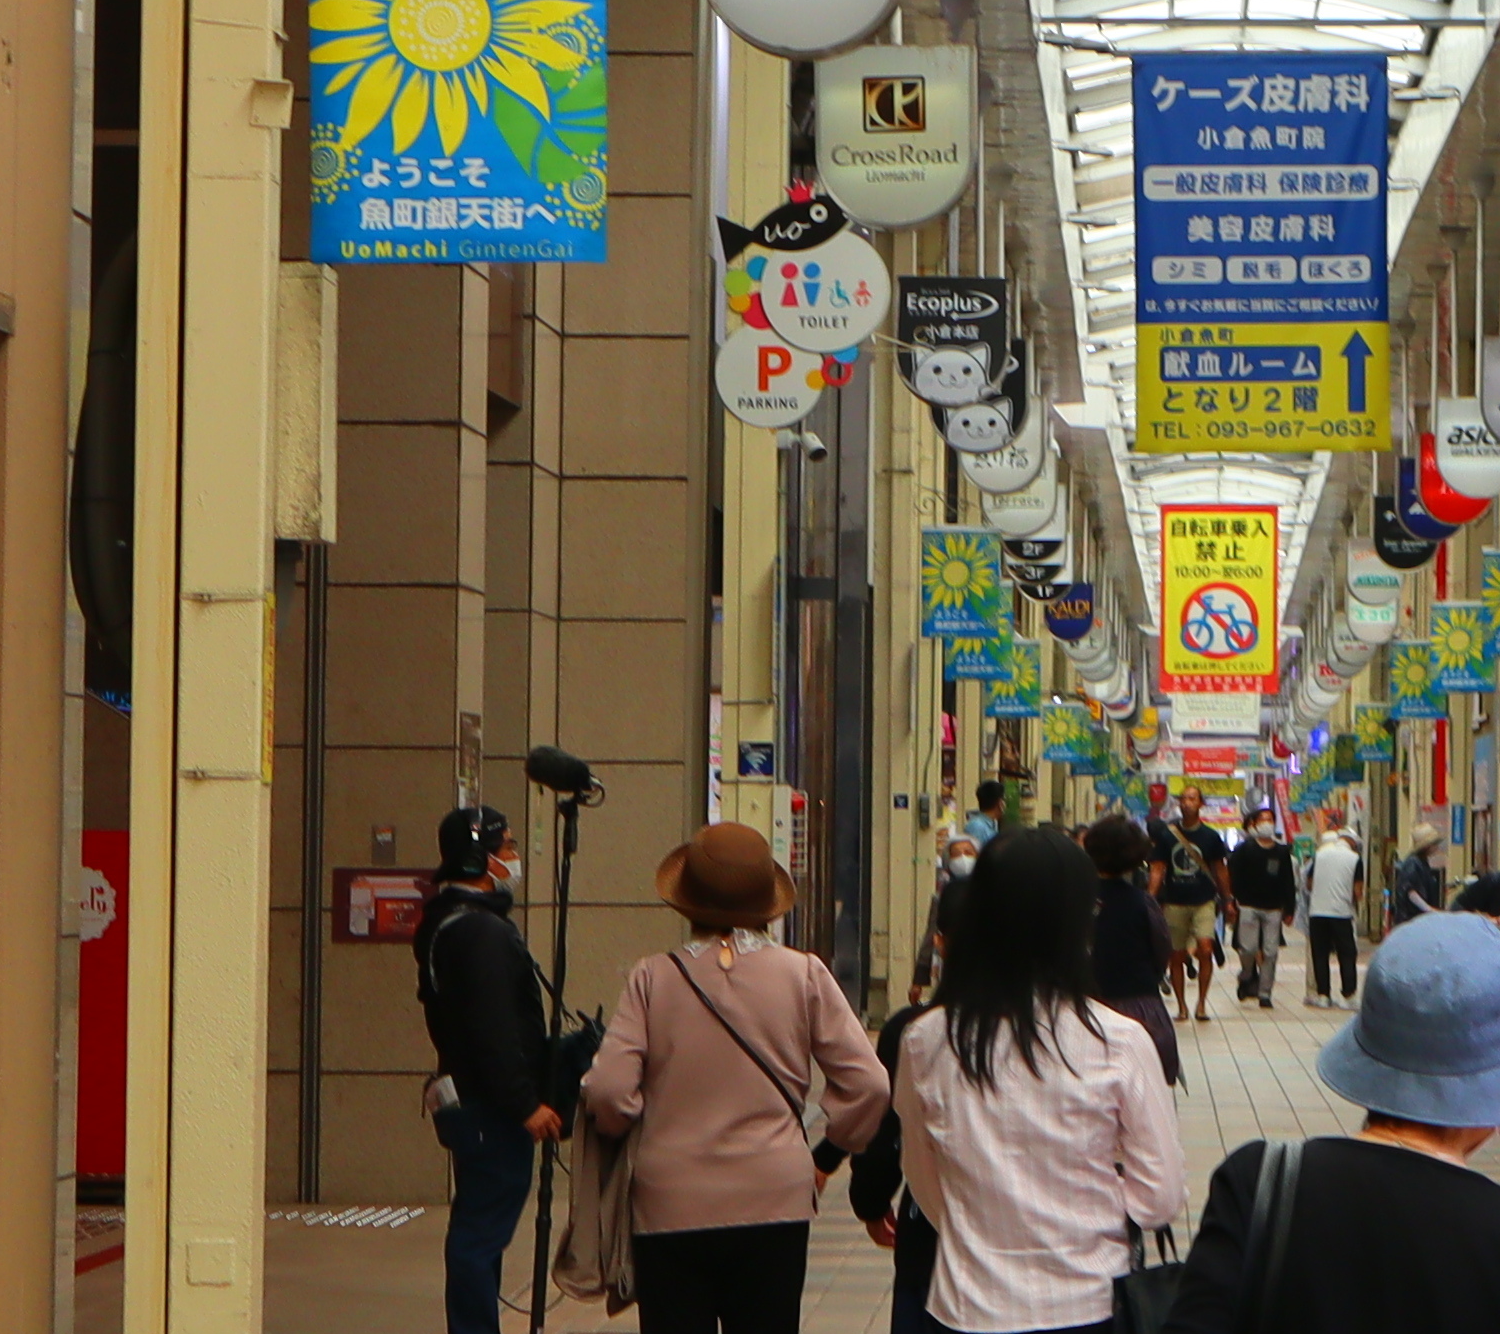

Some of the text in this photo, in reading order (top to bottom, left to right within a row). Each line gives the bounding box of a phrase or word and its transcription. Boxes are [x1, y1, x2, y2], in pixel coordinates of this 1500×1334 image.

[1152, 74, 1369, 113] ケーズ皮膚科
[1197, 126, 1326, 150] 小倉魚町院
[361, 157, 490, 189] ようこそ
[1152, 172, 1369, 194] 一般皮膚科 保険診療
[359, 198, 557, 230] 魚町銀天街へ
[1187, 214, 1335, 242] 美容皮膚科
[341, 239, 575, 259] UoMachi GintenGai
[1169, 262, 1206, 279] シミ
[1242, 262, 1282, 279] 脱毛
[1309, 261, 1363, 279] ほくろ
[906, 292, 982, 317] Ecoplus
[799, 316, 848, 330] TOILET
[1160, 328, 1235, 345] 小倉魚町
[758, 347, 792, 391] P
[1164, 351, 1317, 378] 献血ルーム
[737, 397, 799, 411] PARKING
[1447, 424, 1497, 445] asic
[1172, 518, 1269, 538] 自転車乗入
[1196, 541, 1245, 561] 禁止
